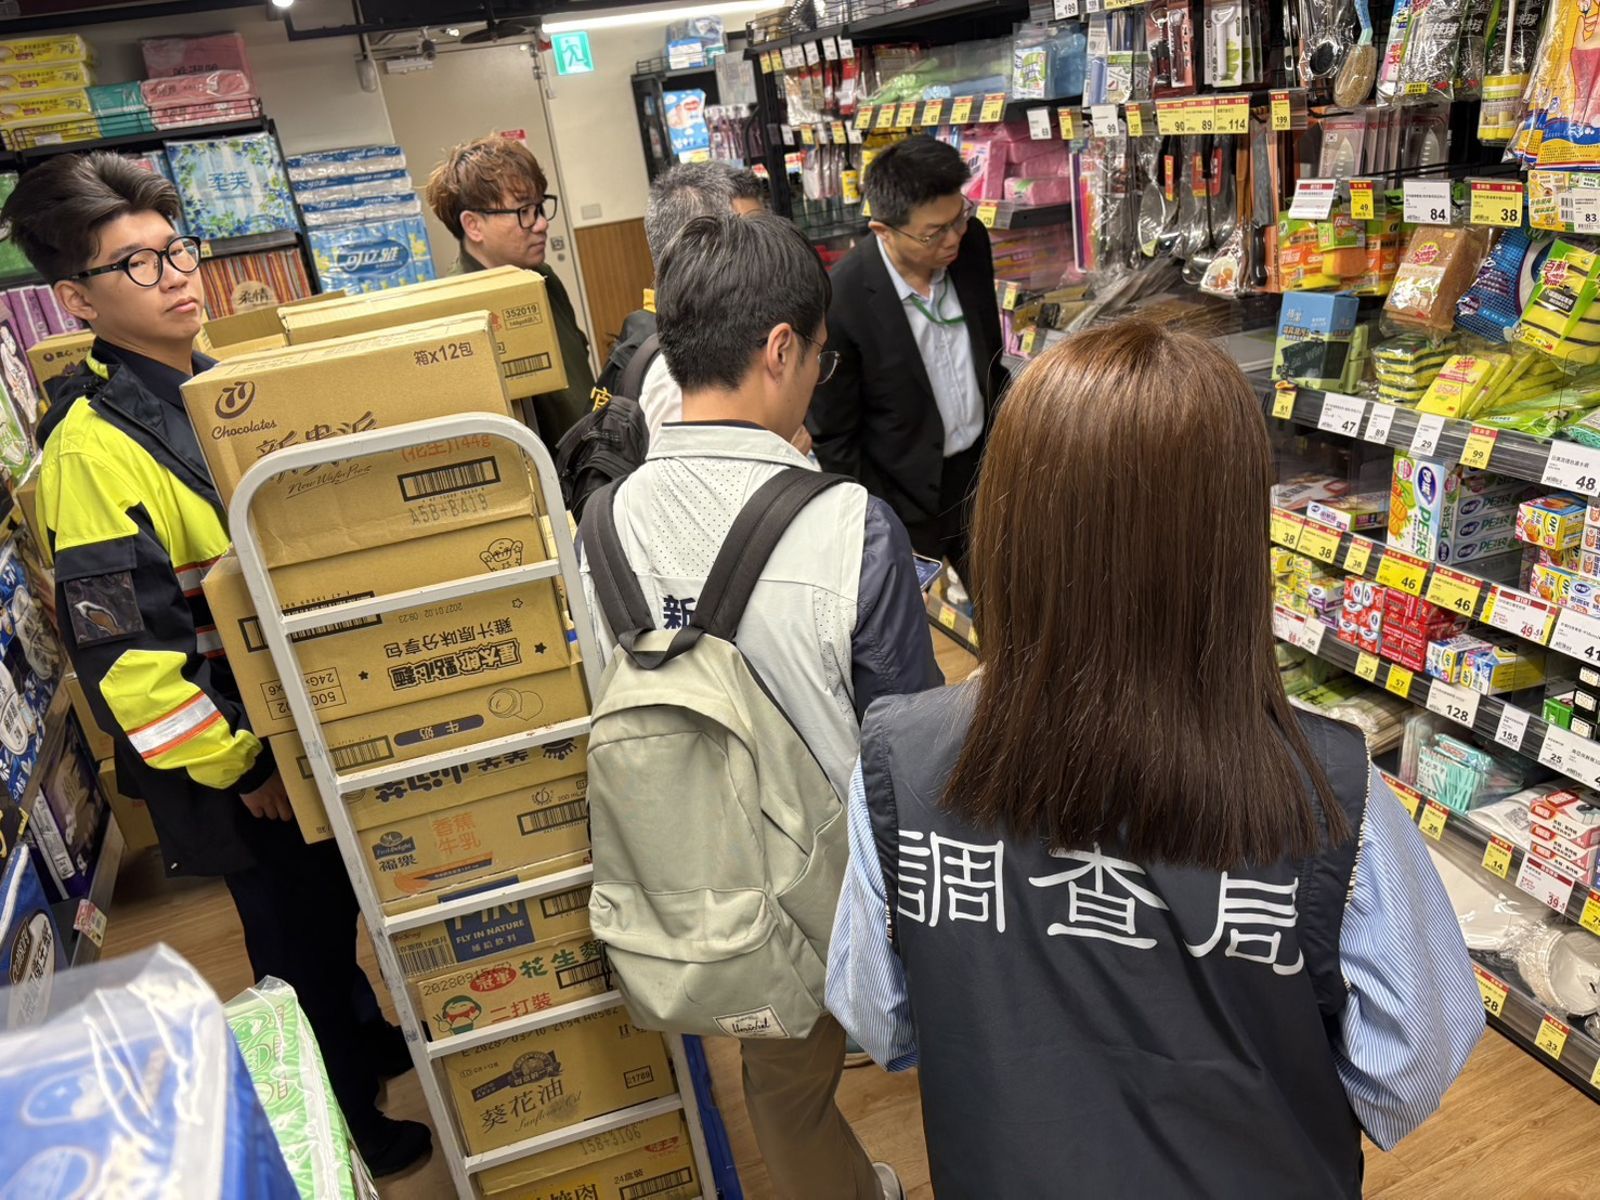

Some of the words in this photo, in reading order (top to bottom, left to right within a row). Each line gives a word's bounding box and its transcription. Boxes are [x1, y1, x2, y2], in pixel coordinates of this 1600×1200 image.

[1175, 121, 1185, 131] 90
[1202, 120, 1212, 130] 89
[1228, 119, 1245, 130] 114
[1430, 208, 1446, 220] 84
[1500, 209, 1517, 222] 38
[1585, 213, 1597, 222] 83
[505, 304, 537, 319] 352019
[211, 419, 278, 440] Chocolates
[1341, 421, 1356, 432] 47
[1421, 440, 1432, 448] 29
[1472, 450, 1484, 459] 99
[1575, 476, 1597, 491] 48
[1283, 533, 1296, 544] 38
[1319, 546, 1332, 559] 38
[1401, 577, 1417, 589] 46
[1454, 598, 1471, 611] 46
[662, 593, 696, 631] 新
[383, 615, 514, 659] 雞汁原味分享包
[1520, 624, 1533, 637] 49
[1446, 704, 1469, 722] 128
[418, 721, 461, 741] 牛奶
[1502, 730, 1519, 743] 155
[1550, 753, 1562, 764] 25
[432, 812, 477, 837] 香蕉
[434, 832, 482, 855] 牛乳
[1492, 860, 1503, 870] 14
[898, 829, 1305, 976] 調查局
[1547, 895, 1559, 908] 39
[456, 932, 473, 944] FLY
[474, 929, 485, 939] IN
[486, 920, 525, 936] NATURE
[490, 992, 552, 1024] 二打裝
[1483, 996, 1499, 1012] 28
[1547, 1041, 1558, 1051] 33
[480, 1078, 564, 1134] 葵花油
